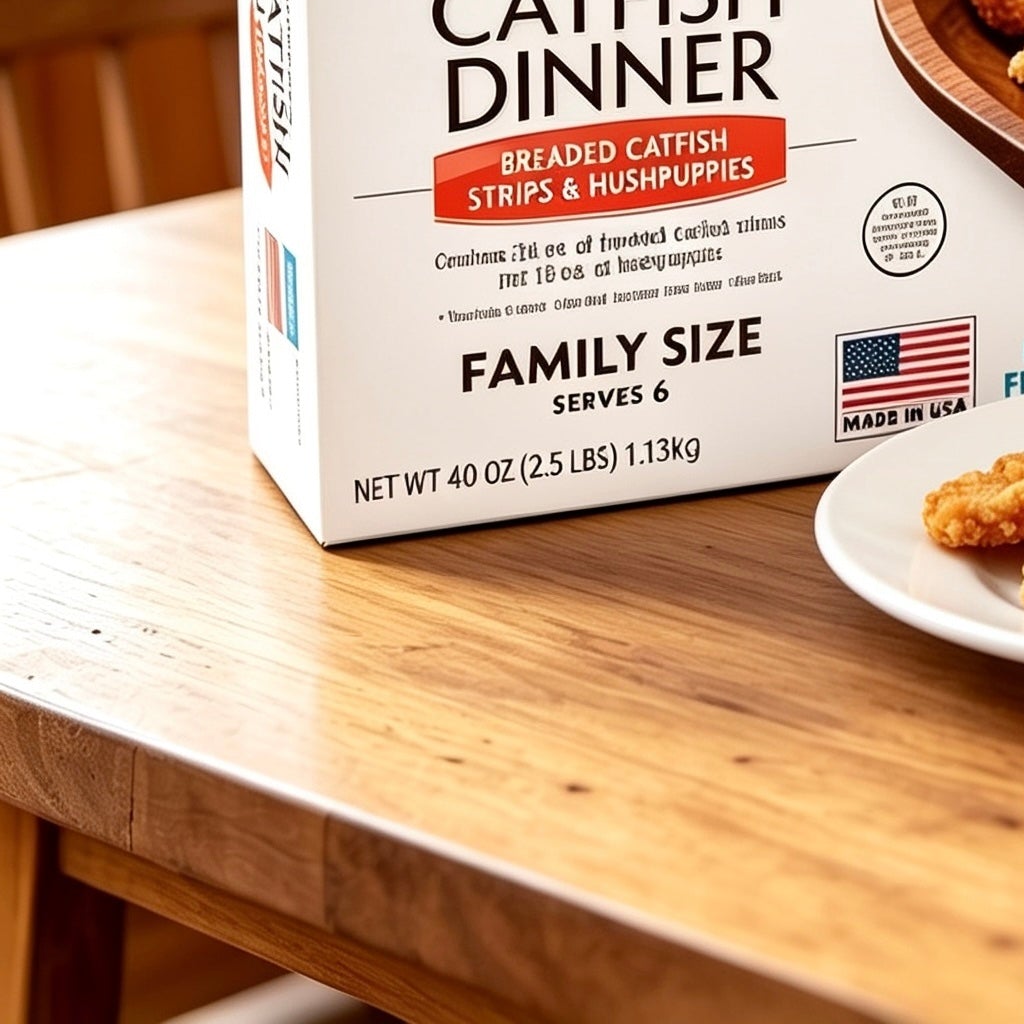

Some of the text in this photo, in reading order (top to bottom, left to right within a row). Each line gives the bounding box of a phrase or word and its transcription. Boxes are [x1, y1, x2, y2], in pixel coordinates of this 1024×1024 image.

[446, 30, 780, 133] DINNER
[500, 127, 728, 177] BREADED CATFISH
[468, 155, 756, 212] STRIPS & HUSHPUPPIES
[462, 316, 762, 394] FAMILY SIZE
[552, 379, 669, 415] SERVES 6
[842, 397, 967, 434] MADE IN USA
[354, 474, 400, 504] NET
[404, 467, 441, 496] WT
[447, 463, 478, 489] 40
[484, 458, 515, 485] OZ
[520, 451, 563, 486] (2.5
[570, 442, 618, 474] LBS)
